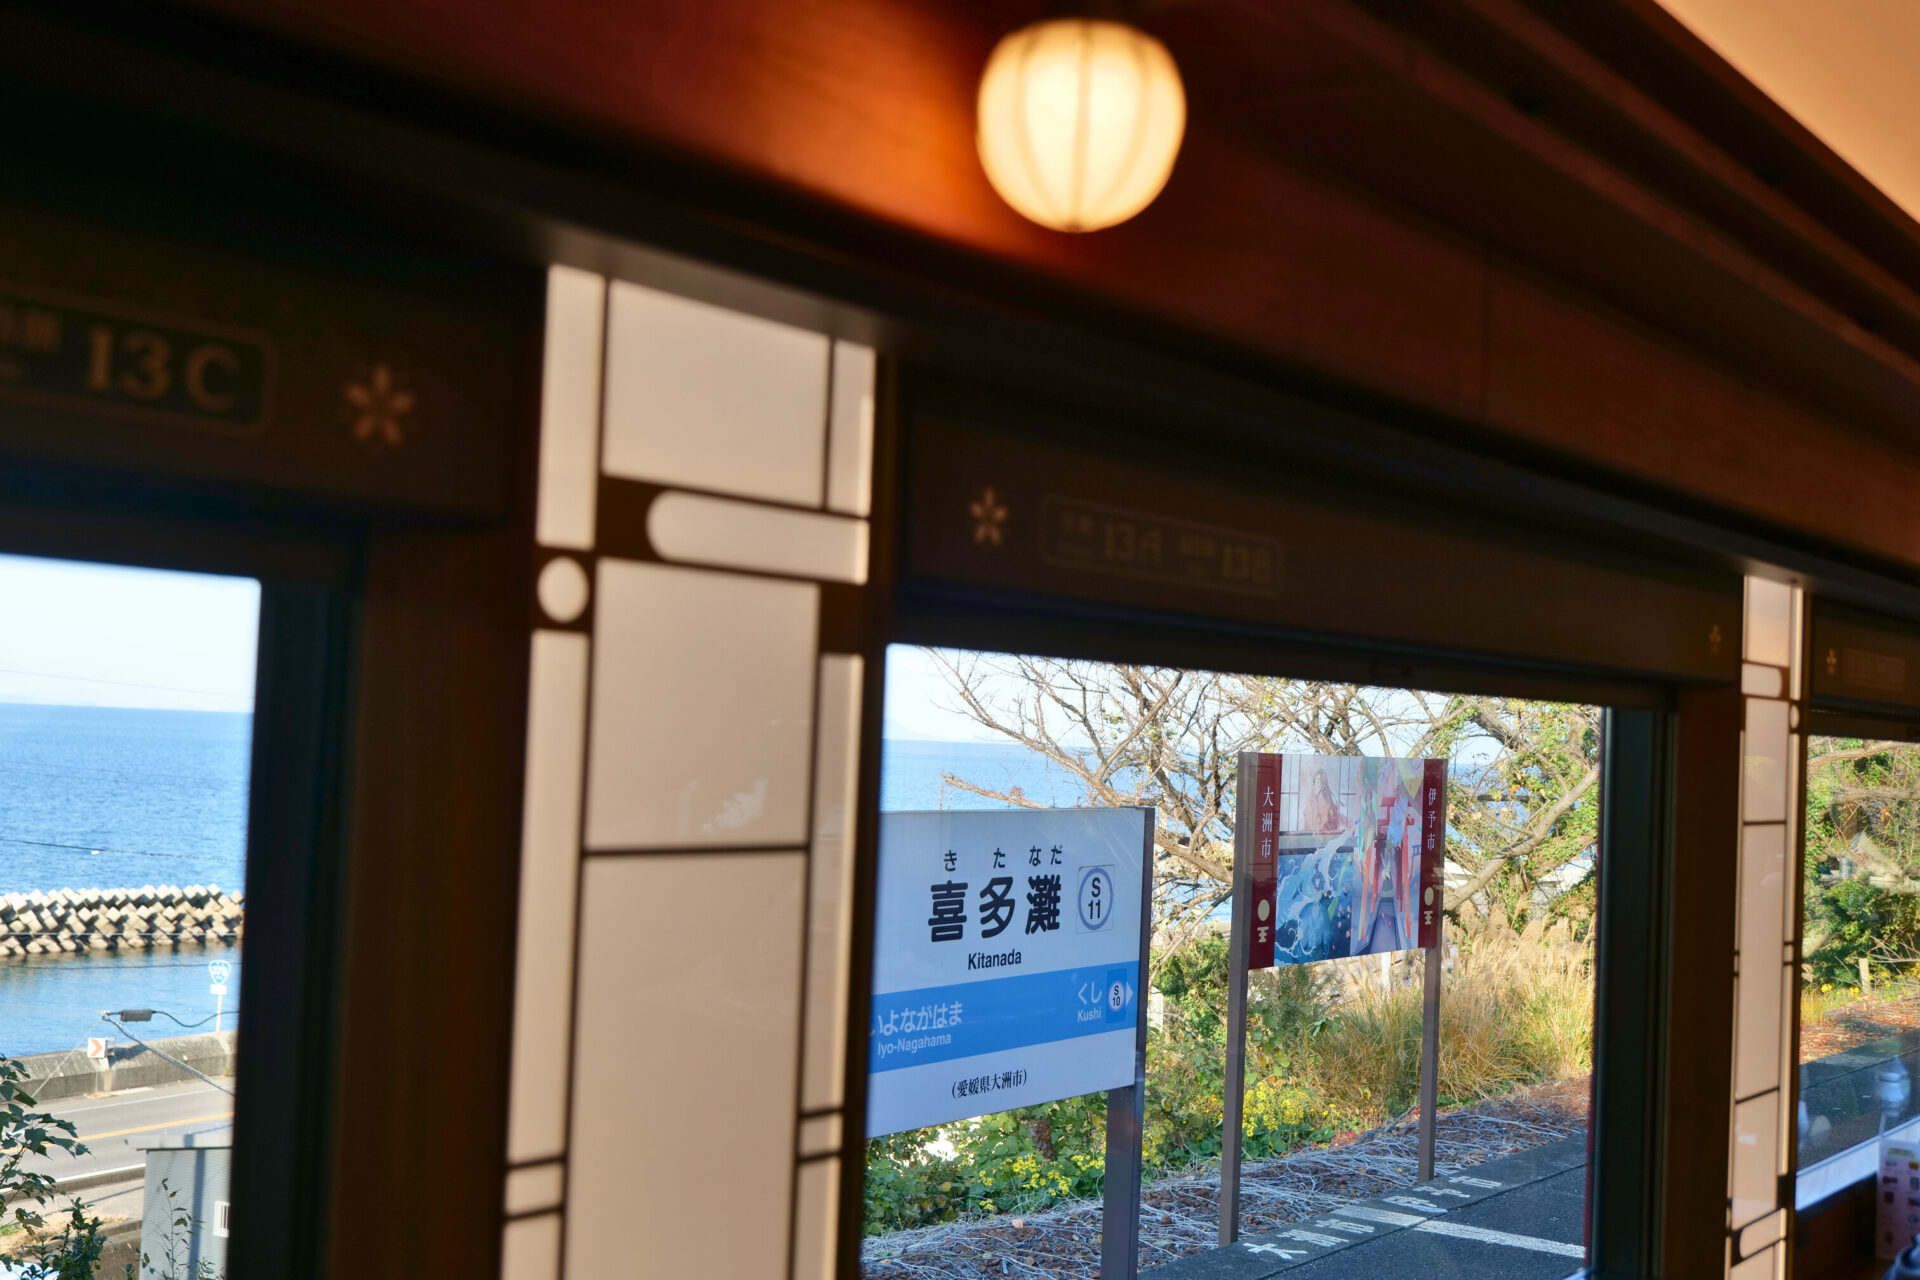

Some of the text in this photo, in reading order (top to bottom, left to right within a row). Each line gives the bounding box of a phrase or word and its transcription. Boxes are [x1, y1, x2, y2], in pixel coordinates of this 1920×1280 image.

[1262, 786, 1274, 859] 大洲市
[1427, 787, 1437, 851] 伊予市
[1091, 877, 1101, 898] S
[927, 874, 1062, 942] 喜多灘
[1088, 899, 1101, 919] 11
[967, 948, 1022, 970] Kitanada
[1077, 981, 1103, 1005] くし
[1112, 996, 1121, 1007] 10
[1077, 1007, 1102, 1022] Kushi
[878, 1033, 952, 1058] Iyo-Nagahama
